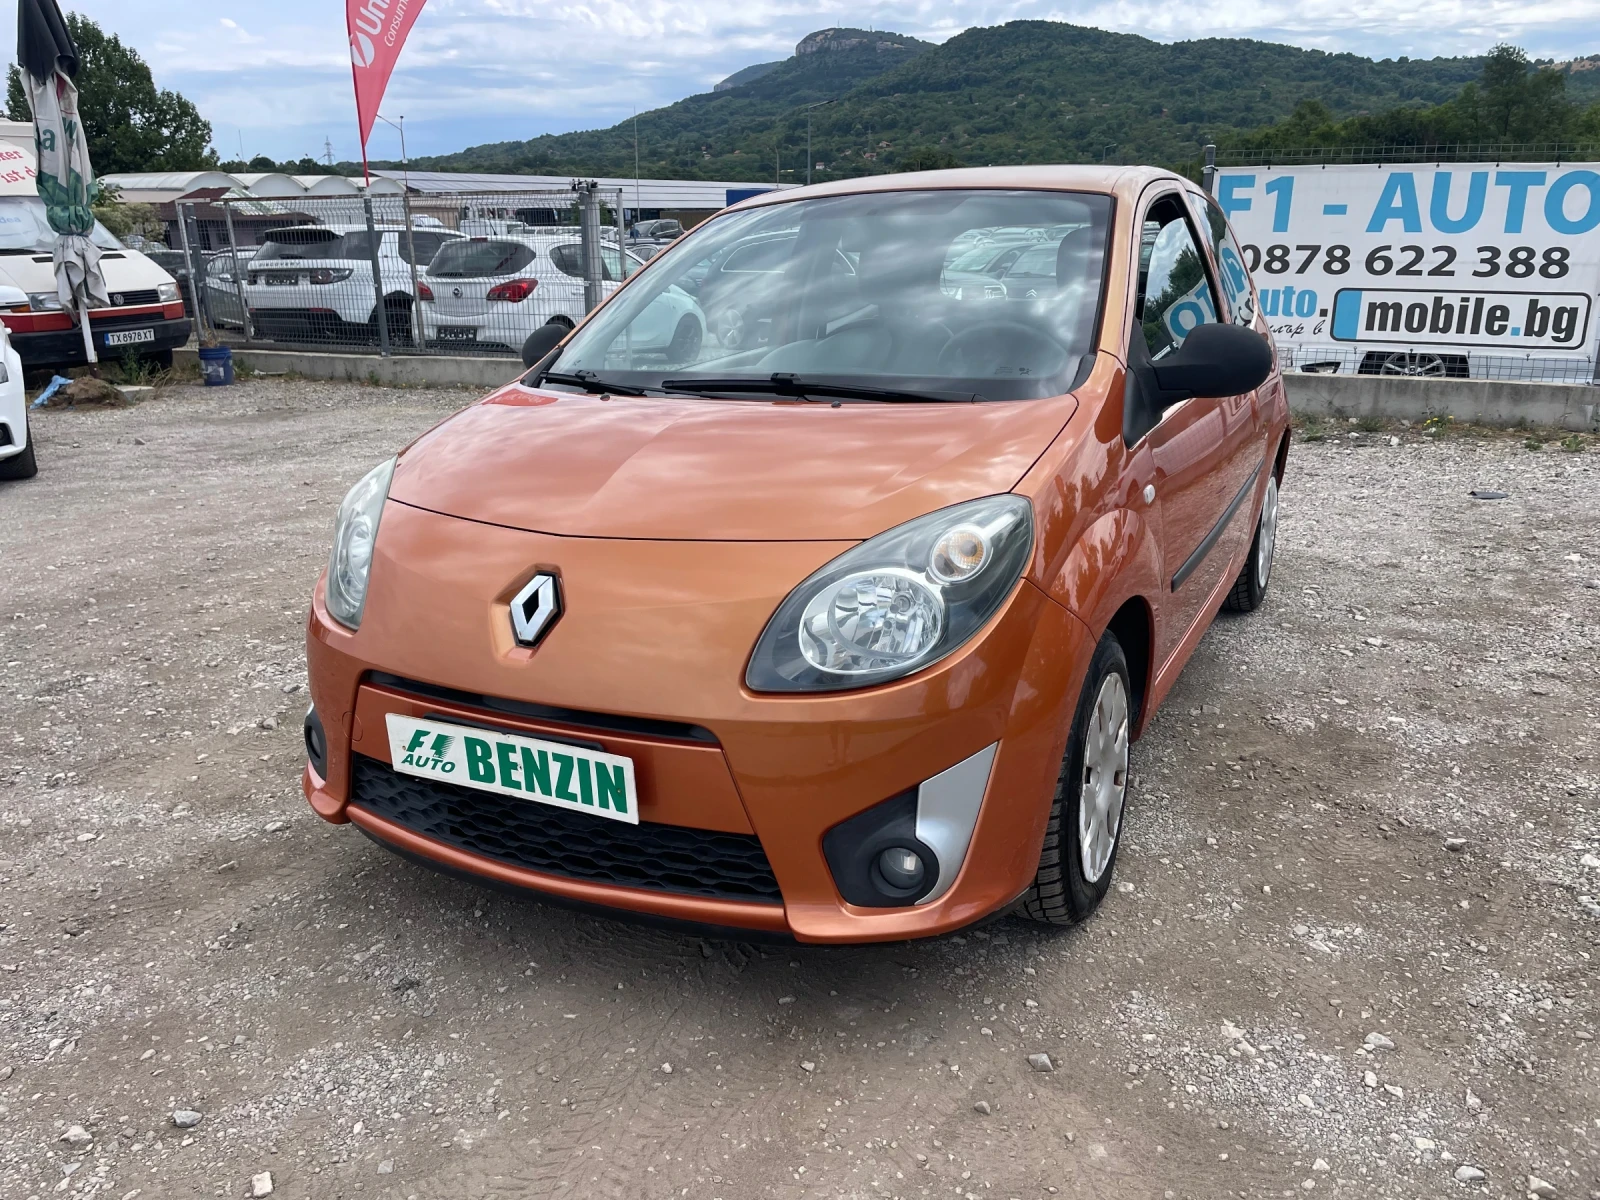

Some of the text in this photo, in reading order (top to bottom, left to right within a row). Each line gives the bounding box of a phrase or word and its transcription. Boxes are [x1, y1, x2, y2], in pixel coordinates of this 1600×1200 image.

[384, 0, 410, 47] Consum
[1217, 174, 1295, 233] F1
[1365, 169, 1600, 235] AUTO
[1241, 244, 1570, 279] 0878 622 388
[1364, 296, 1579, 343] mobile.bg
[401, 753, 456, 774] AUTO
[464, 736, 628, 814] BENZIN
